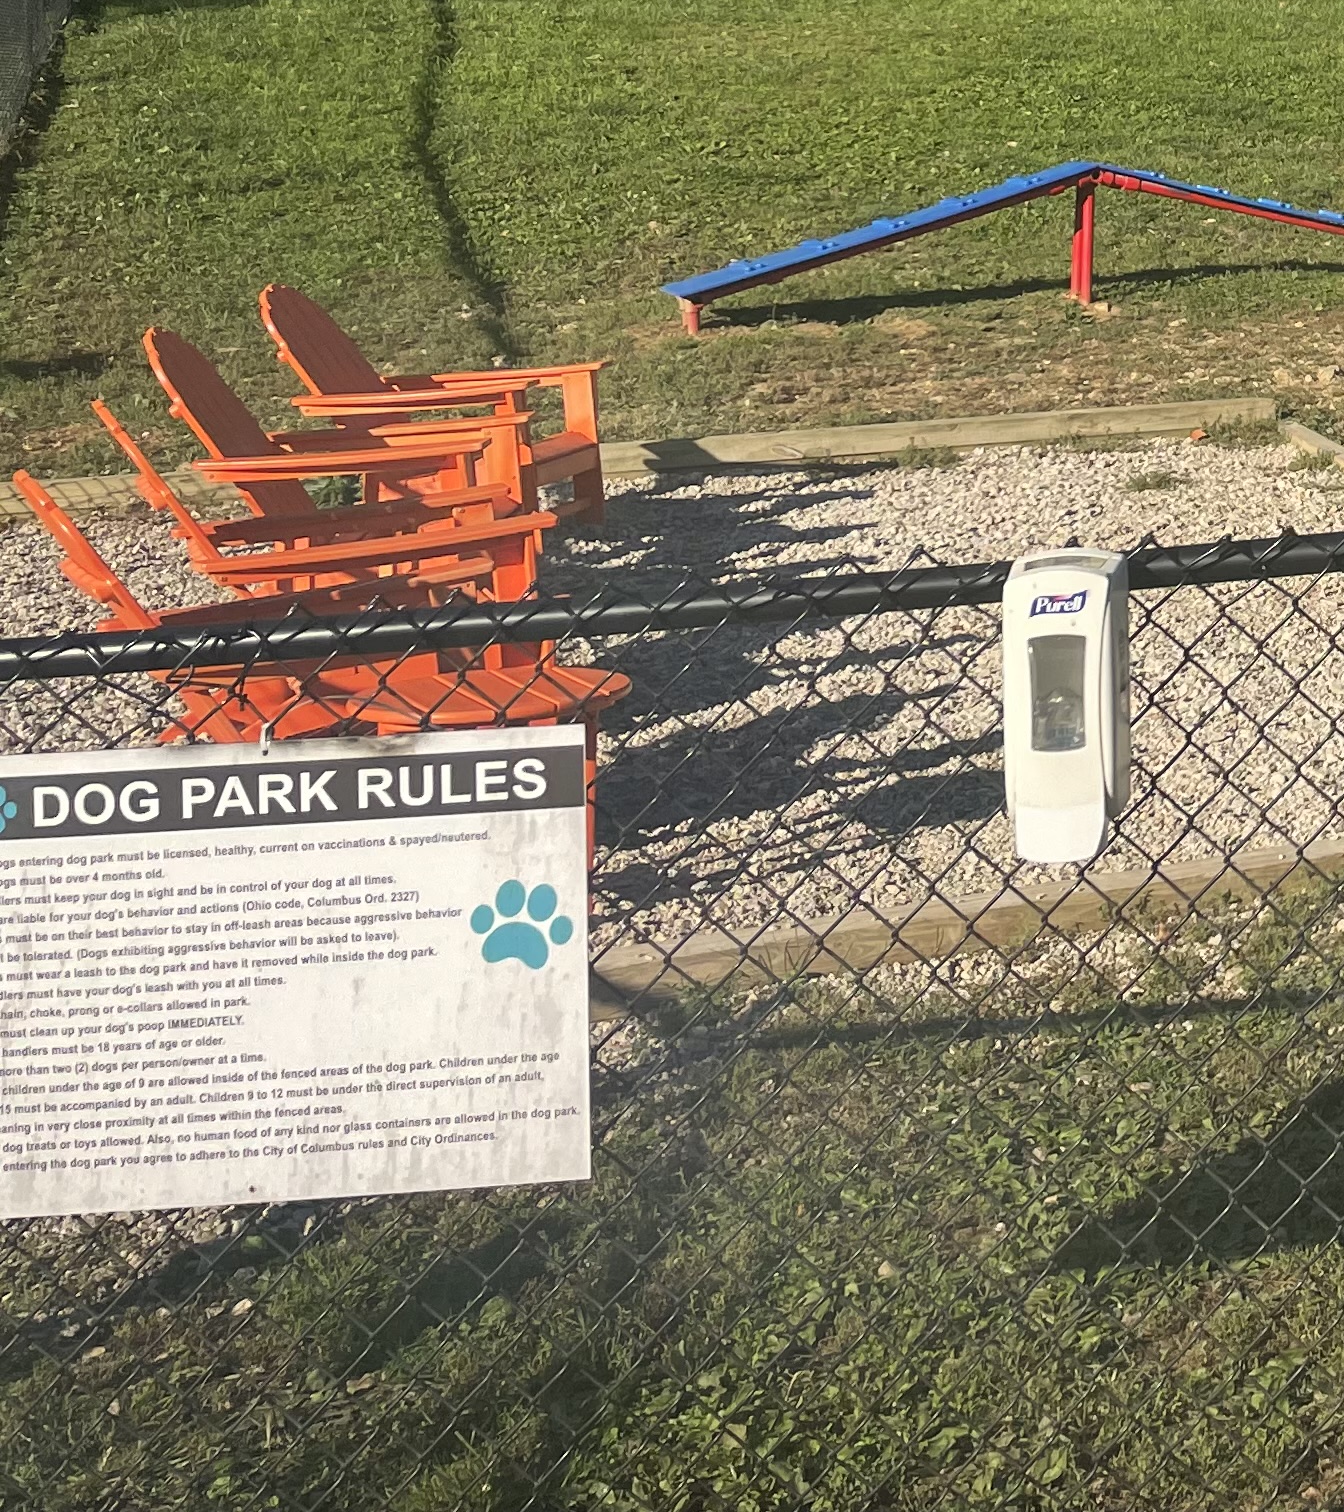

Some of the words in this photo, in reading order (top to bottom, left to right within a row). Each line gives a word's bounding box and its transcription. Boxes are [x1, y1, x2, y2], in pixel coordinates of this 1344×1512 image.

[33, 786, 160, 827] DOG
[181, 771, 338, 820] PARK
[357, 758, 547, 809] RULES
[18, 855, 64, 868] entering
[66, 854, 87, 867] dog
[89, 852, 114, 866] park
[116, 851, 144, 862] must
[146, 850, 160, 860] be
[259, 842, 298, 854] current
[300, 842, 315, 852] on
[317, 837, 385, 850] vaccinations
[4, 930, 32, 944] must
[34, 932, 48, 942] be
[50, 933, 65, 941] on
[67, 926, 92, 941] their
[95, 928, 119, 939] best
[121, 925, 168, 938] behavior
[171, 925, 182, 935] to
[185, 924, 208, 936] stay
[210, 922, 221, 932] in
[273, 919, 303, 929] areas
[306, 916, 351, 926] because
[353, 910, 412, 926] aggressive
[414, 907, 461, 920] behavior
[16, 911, 46, 924] liable
[48, 911, 64, 923] for
[66, 912, 91, 924] your
[126, 906, 174, 918] behavior
[176, 904, 197, 915] and
[199, 903, 239, 914] actions
[306, 895, 361, 908] Columbus
[6, 952, 20, 963] be
[111, 945, 165, 957] exhibiting
[167, 940, 226, 956] aggressive
[228, 938, 276, 950] behavior
[278, 936, 297, 947] will
[299, 935, 313, 946] be
[316, 932, 348, 945] asked
[350, 933, 362, 943] to
[0, 1025, 27, 1039] must
[29, 1027, 58, 1038] clean
[60, 1027, 75, 1038] up
[77, 1025, 101, 1037] your
[137, 1022, 165, 1034] poop
[1, 1044, 48, 1058] handlers
[51, 1044, 78, 1055] must
[80, 1043, 94, 1054] be
[112, 1042, 142, 1055] years
[144, 1039, 156, 1050] of
[158, 1040, 178, 1052] age
[180, 1039, 192, 1048] or
[1, 1082, 46, 1096] children
[48, 1082, 79, 1094] under
[82, 1081, 99, 1092] the
[102, 1081, 122, 1093] age
[124, 1078, 136, 1089] of
[147, 1079, 165, 1088] are
[167, 1074, 209, 1087] allowed
[211, 1072, 244, 1084] inside
[247, 1070, 258, 1082] of
[260, 1070, 278, 1081] the
[280, 1067, 317, 1079] fenced
[319, 1067, 349, 1077] areas
[351, 1063, 363, 1075] of
[365, 1063, 383, 1074] the
[385, 1062, 406, 1074] dog
[438, 1057, 484, 1069] Children
[486, 1053, 517, 1065] under
[520, 1053, 537, 1063] the
[540, 1052, 559, 1064] age
[13, 1103, 41, 1115] must
[43, 1102, 57, 1113] be
[59, 1097, 131, 1112] accompanied
[133, 1097, 147, 1110] by
[149, 1097, 163, 1107] an
[198, 1091, 245, 1104] Children
[256, 1090, 268, 1100] to
[285, 1086, 313, 1098] must
[315, 1085, 329, 1096] be
[331, 1082, 362, 1095] under
[365, 1079, 383, 1093] the
[385, 1080, 416, 1091] direct
[419, 1075, 482, 1091] supervision
[484, 1073, 496, 1084] of
[497, 1074, 512, 1084] an
[2, 1142, 23, 1155] dog
[25, 1137, 57, 1152] treats
[59, 1141, 71, 1150] or
[73, 1139, 97, 1151] toys
[176, 1134, 191, 1143] no
[193, 1131, 230, 1142] human
[232, 1127, 258, 1139] food
[260, 1126, 272, 1138] of
[274, 1127, 293, 1139] any
[296, 1121, 320, 1135] kind
[322, 1124, 340, 1134] nor
[343, 1118, 372, 1135] glass
[374, 1117, 431, 1130] containers
[434, 1117, 451, 1126] are
[453, 1111, 495, 1124] allowed
[497, 1110, 508, 1121] in
[510, 1110, 528, 1120] the
[530, 1108, 551, 1120] dog
[2, 1157, 47, 1172] entering
[49, 1158, 67, 1169] the
[69, 1157, 91, 1170] dog
[93, 1155, 117, 1169] park
[119, 1154, 140, 1168] you
[142, 1154, 173, 1166] agree
[175, 1152, 187, 1162] to
[189, 1150, 226, 1161] adhere
[228, 1145, 240, 1159] to
[242, 1147, 259, 1158] the
[262, 1142, 284, 1158] City
[286, 1143, 298, 1155] of
[300, 1141, 354, 1154] Columbus
[357, 1139, 384, 1150] rules
[387, 1136, 408, 1148] and
[410, 1135, 431, 1149] City
